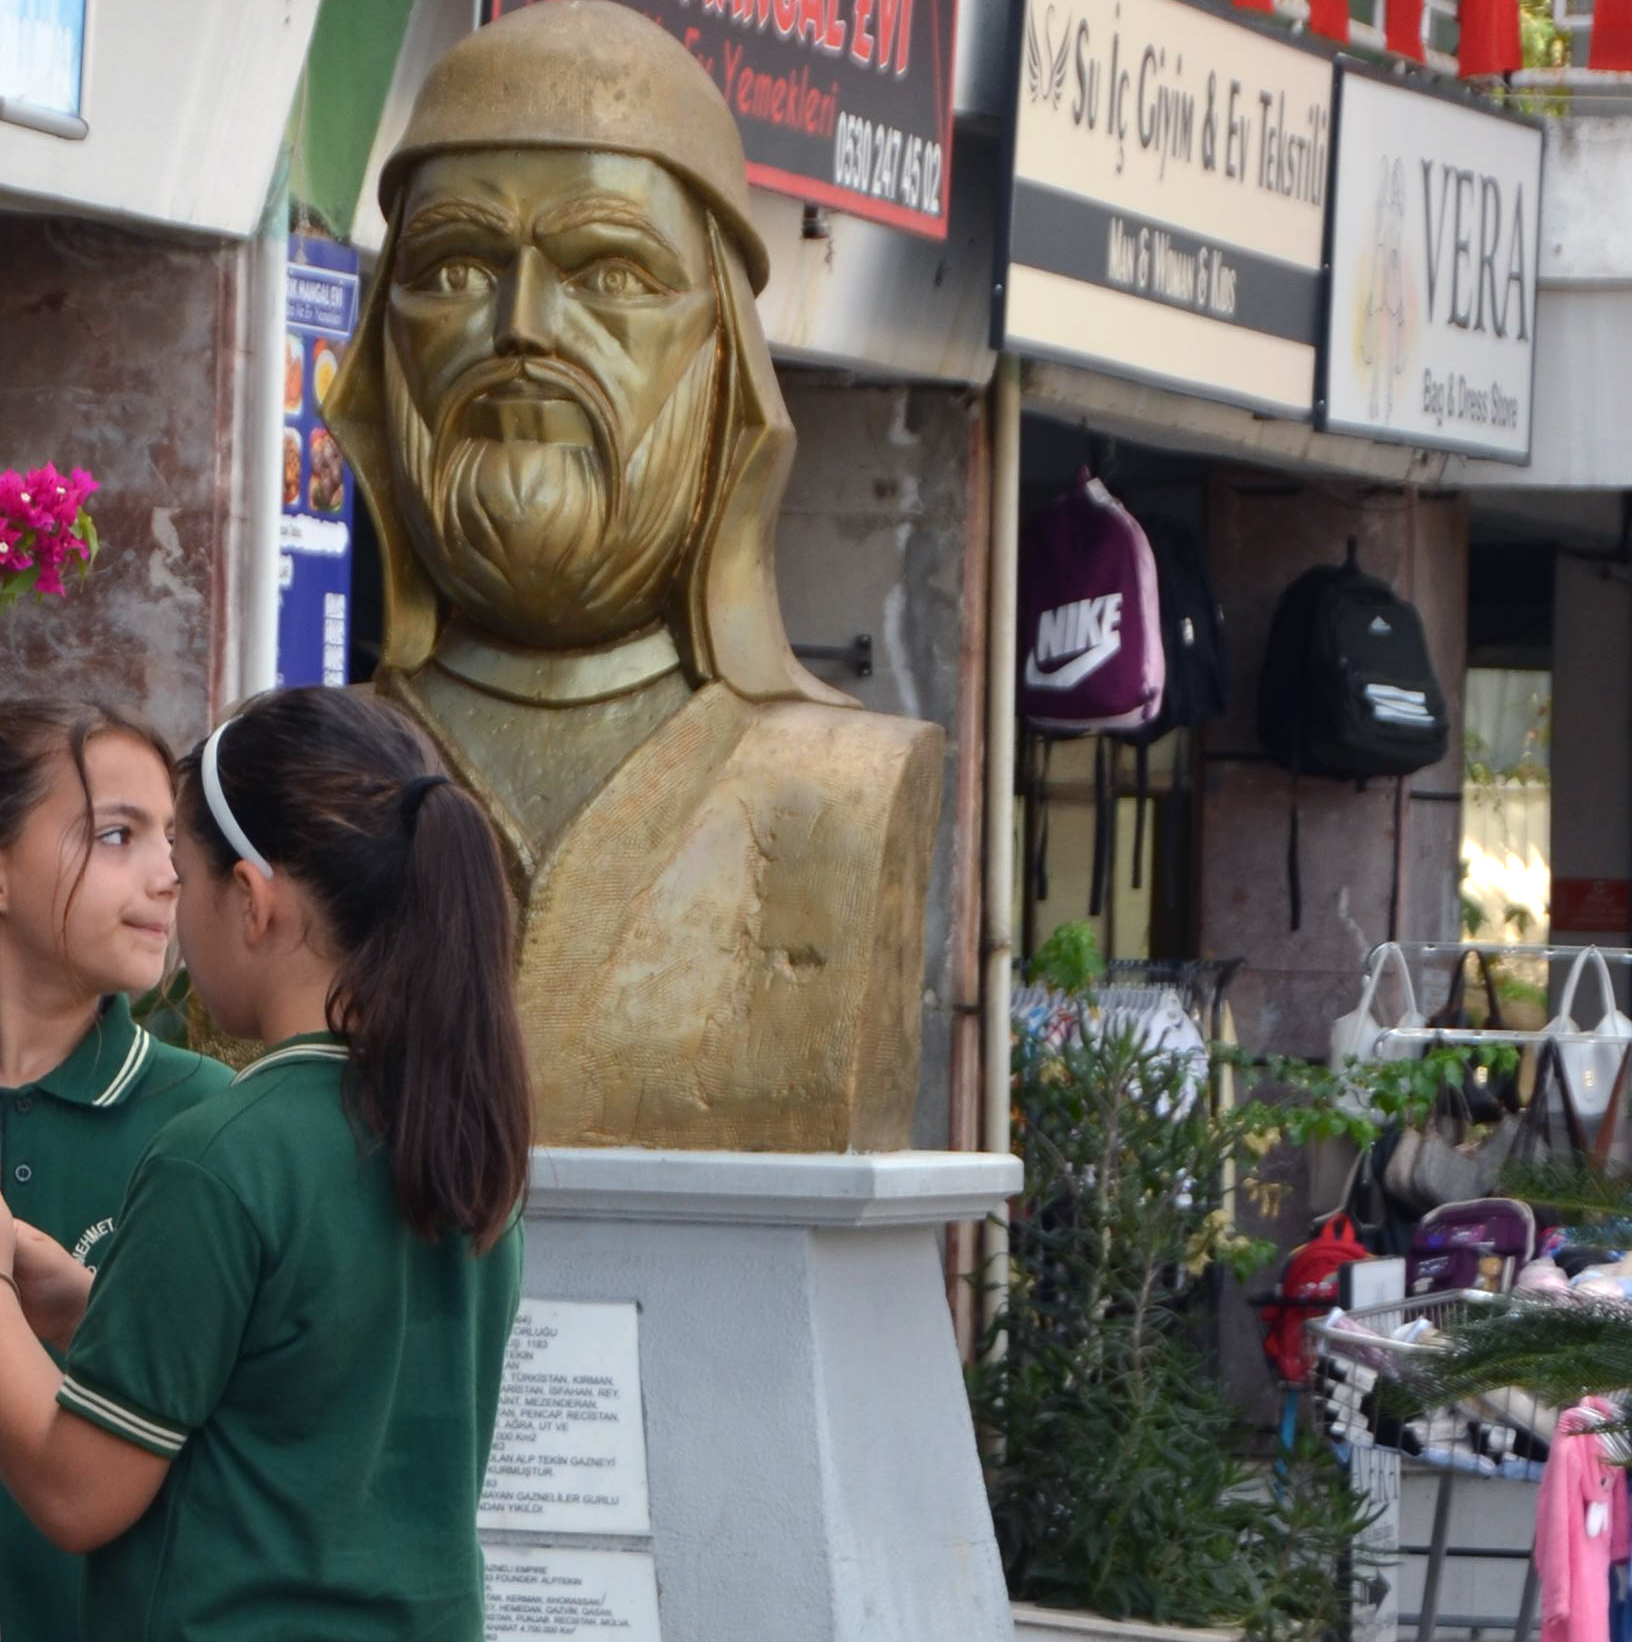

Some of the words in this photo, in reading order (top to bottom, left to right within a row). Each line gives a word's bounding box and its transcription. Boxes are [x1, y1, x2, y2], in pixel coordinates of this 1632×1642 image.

[723, 38, 840, 142] Yemekleri
[1072, 17, 1101, 131] Su
[1201, 69, 1219, 172] &
[834, 110, 872, 191] 0530
[872, 123, 903, 200] 247
[901, 133, 923, 208] 45
[922, 140, 943, 215] 02
[1137, 226, 1150, 289] &
[1197, 245, 1209, 306] &
[1420, 157, 1530, 343] VERA
[1423, 366, 1445, 427] Bag
[1037, 592, 1123, 661] NIKE
[514, 1325, 558, 1337] ORLUĞU
